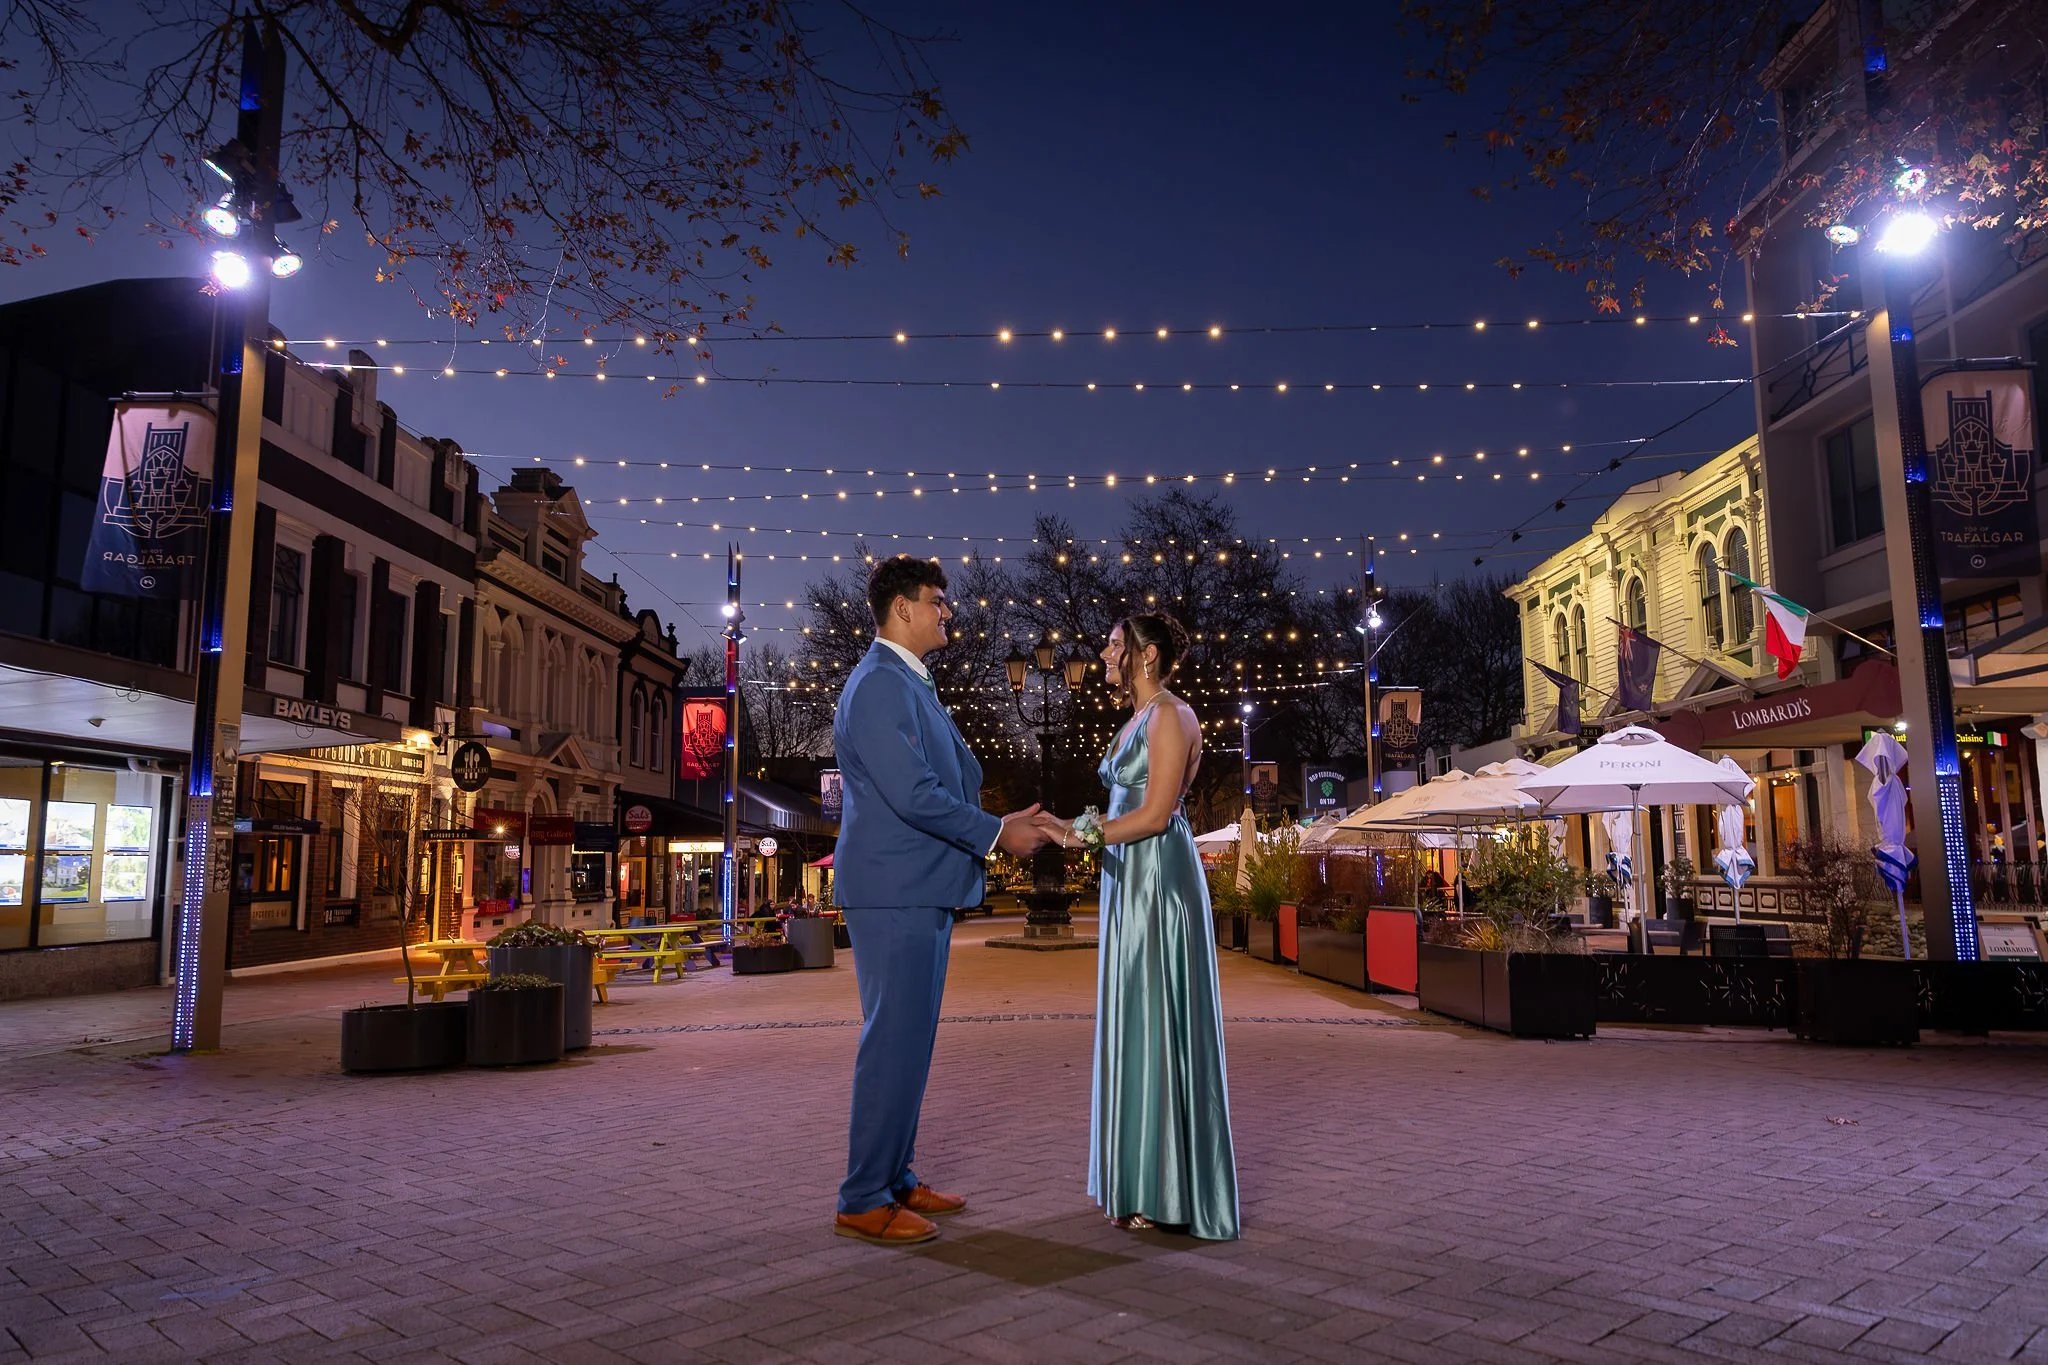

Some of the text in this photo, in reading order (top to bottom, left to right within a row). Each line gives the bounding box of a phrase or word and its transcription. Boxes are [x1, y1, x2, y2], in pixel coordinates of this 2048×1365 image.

[1940, 532, 2024, 543] TRAFALGAR
[274, 698, 351, 729] BAYLEYS
[1599, 759, 1662, 769] PERONI
